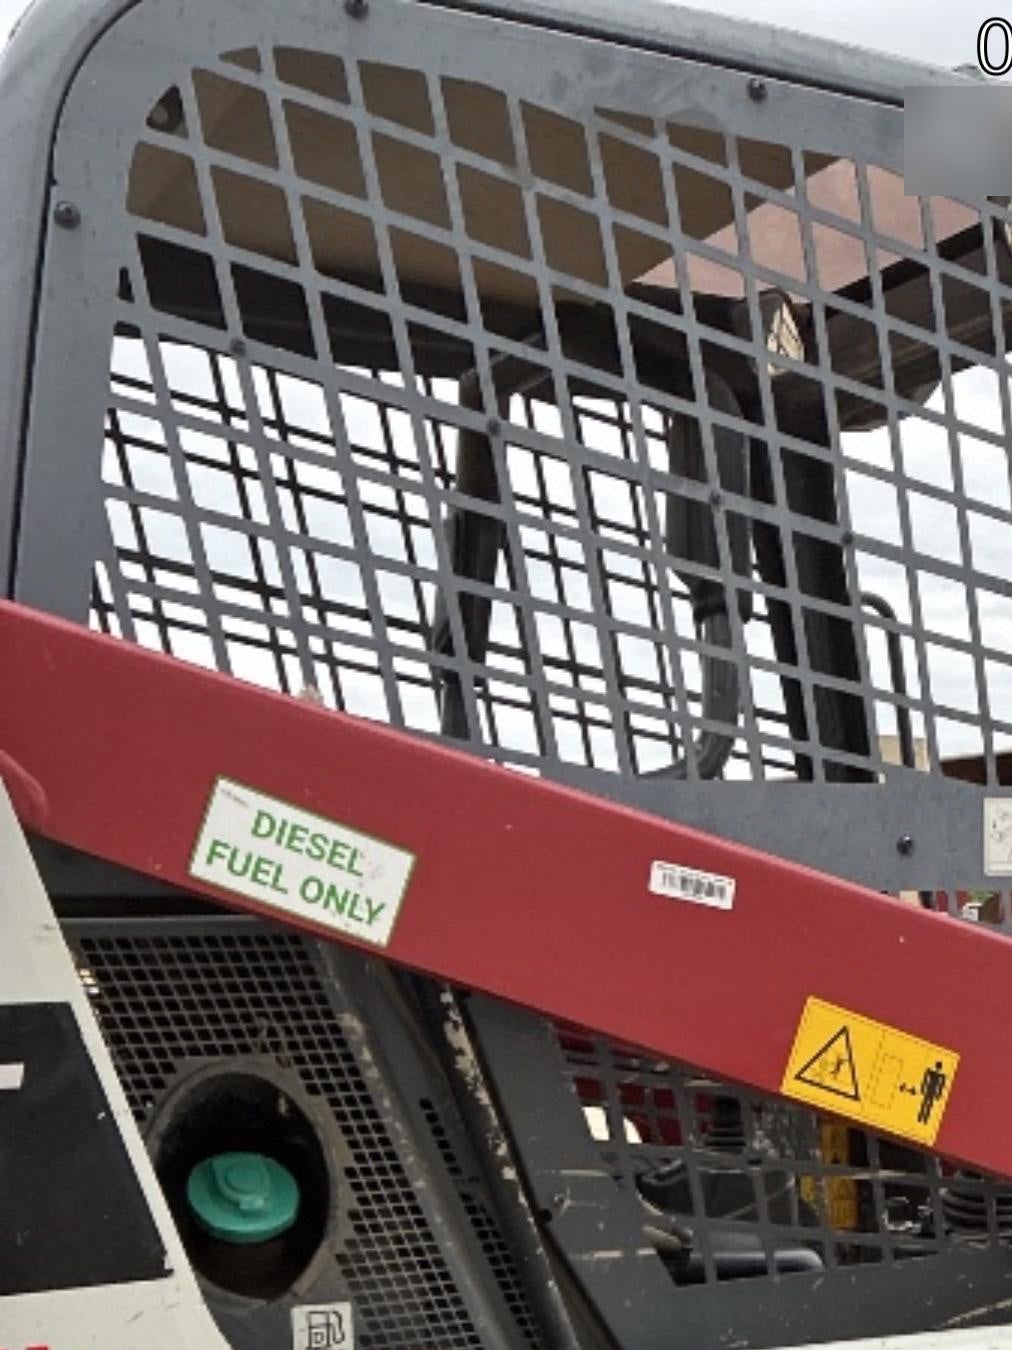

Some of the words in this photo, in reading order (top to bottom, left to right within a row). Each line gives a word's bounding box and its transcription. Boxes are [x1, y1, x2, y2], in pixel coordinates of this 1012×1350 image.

[205, 838, 289, 895] FUEL
[299, 875, 386, 926] ONLY
[251, 809, 364, 878] DIESEL
